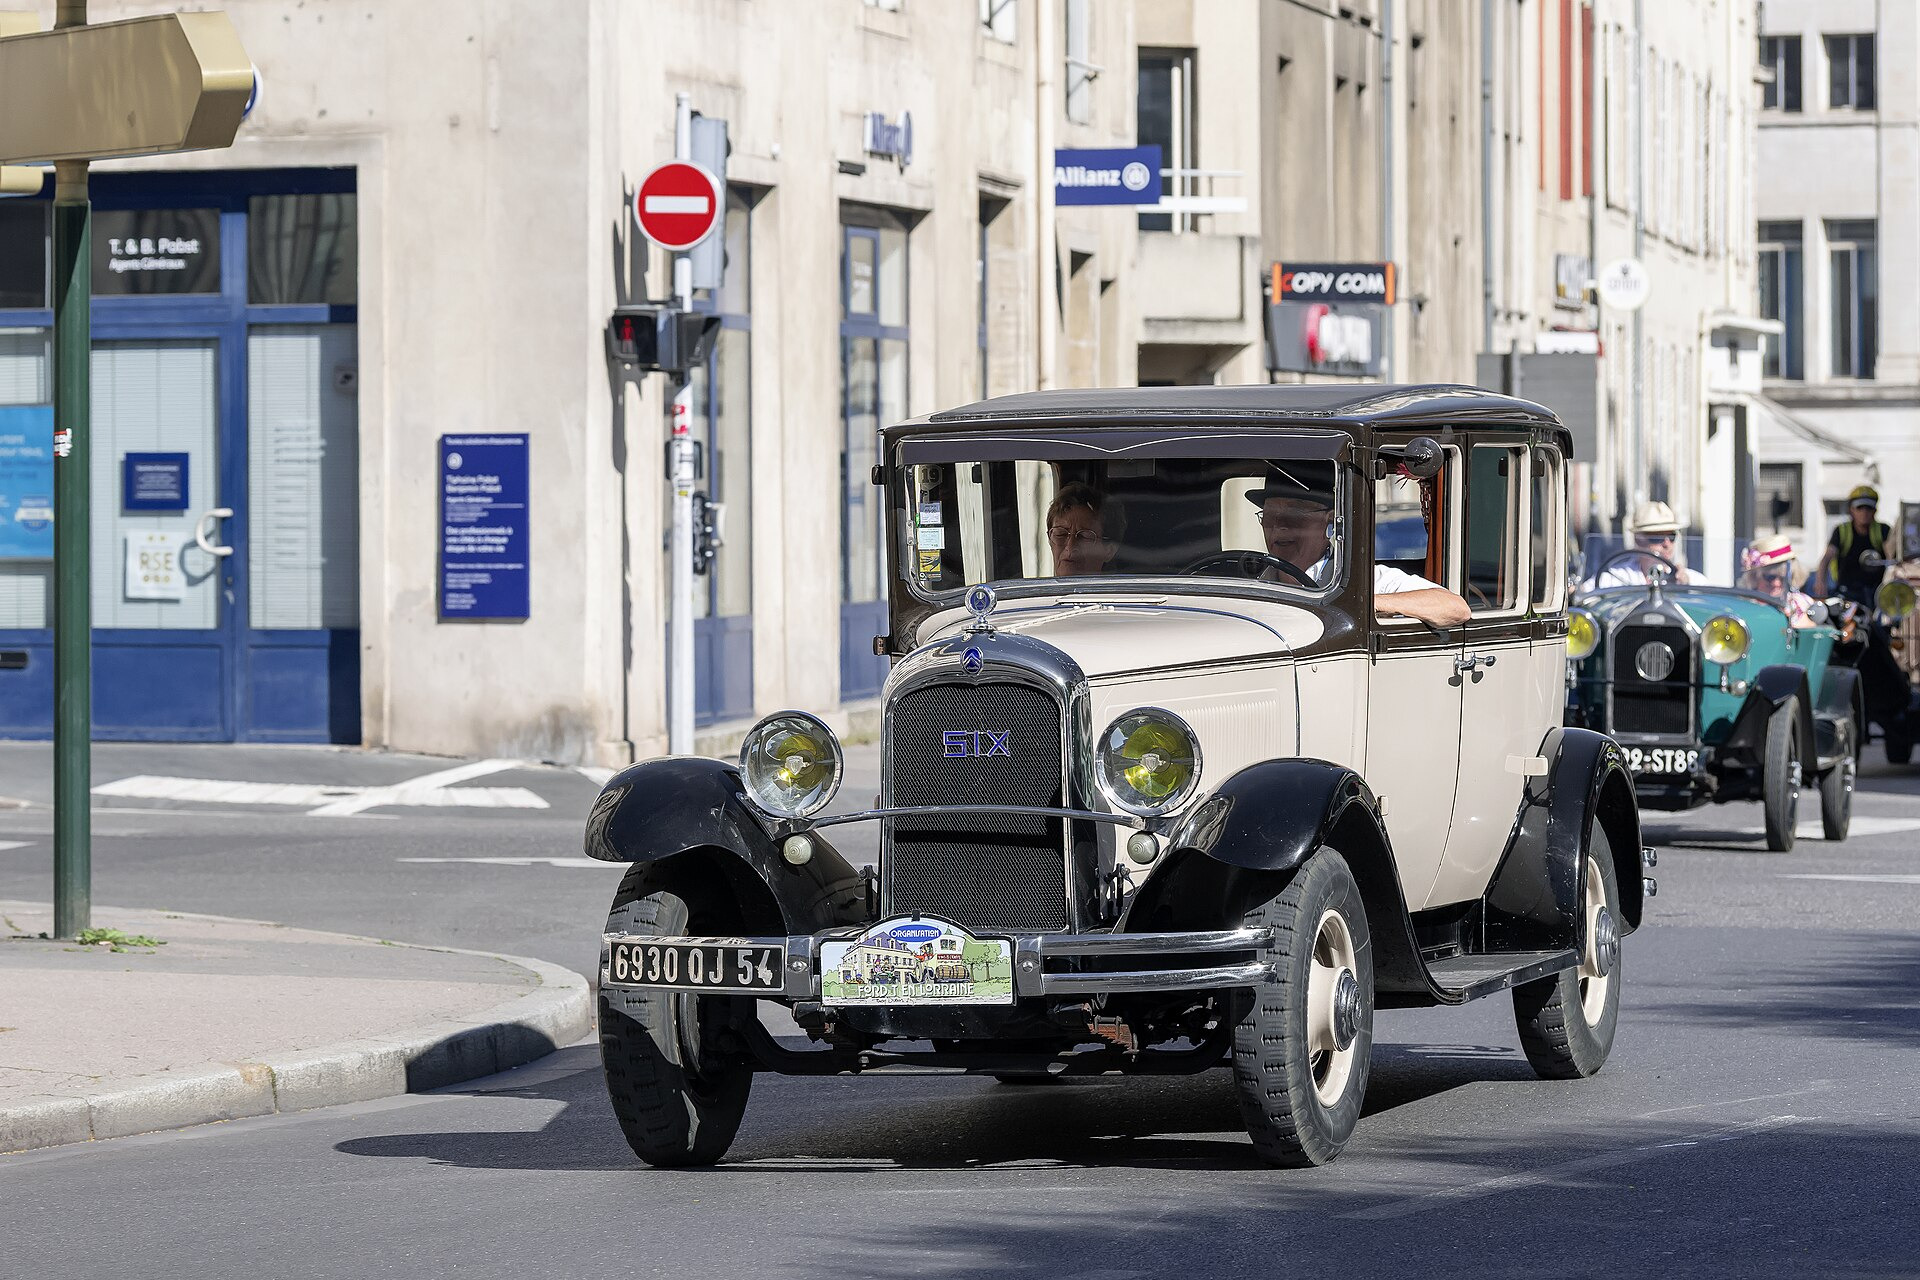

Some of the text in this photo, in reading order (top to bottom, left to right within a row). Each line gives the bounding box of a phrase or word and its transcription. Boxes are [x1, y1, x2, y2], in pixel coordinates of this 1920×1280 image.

[1055, 166, 1121, 187] Allianz
[108, 238, 123, 255] T.
[1282, 272, 1385, 294] COPY COM
[943, 730, 1010, 757] SIX
[890, 928, 940, 938] ORGANISATION
[615, 944, 678, 983] 6930
[737, 949, 773, 986] 54
[858, 985, 888, 997] FORD
[902, 984, 917, 997] EN
[920, 983, 975, 996] LORRAINE
